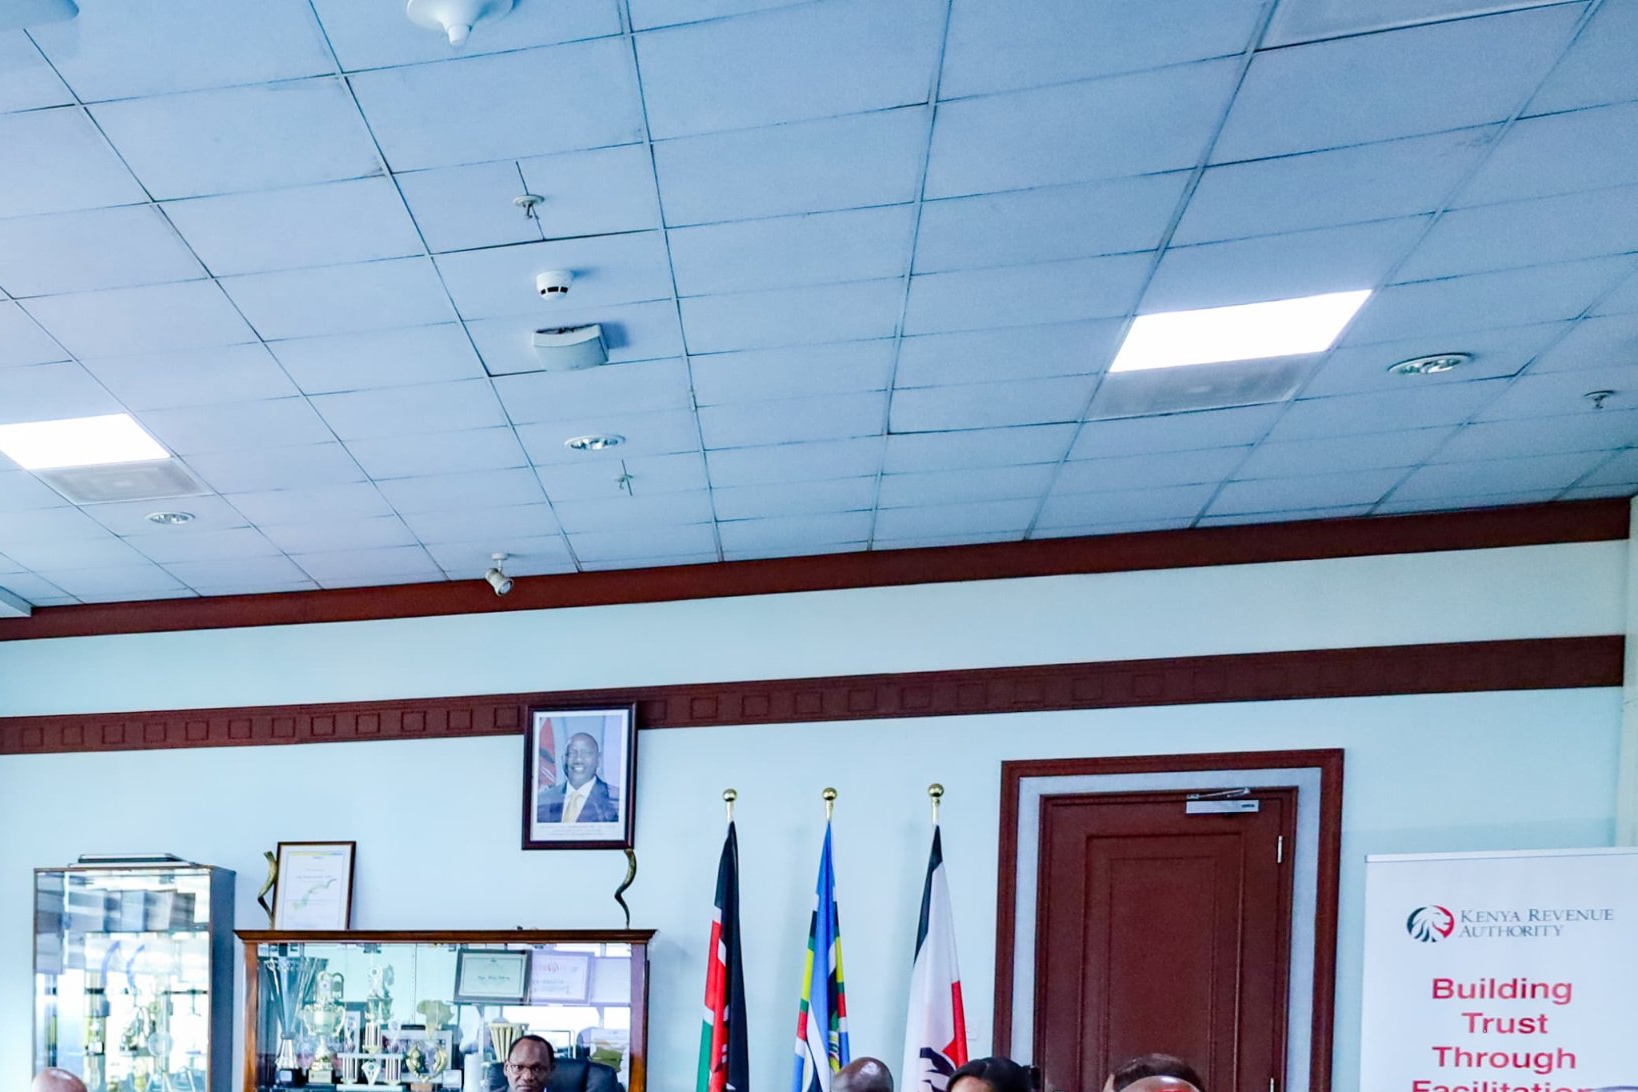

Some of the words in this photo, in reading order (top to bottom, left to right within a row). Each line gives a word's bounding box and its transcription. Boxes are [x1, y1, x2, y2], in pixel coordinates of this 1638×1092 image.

[1461, 910, 1521, 923] KENYA
[1529, 908, 1614, 922] REVENUE
[1459, 925, 1563, 938] AUTHORITY
[1432, 978, 1573, 1005] Building
[1461, 1011, 1549, 1035] Trust
[1432, 1047, 1577, 1075] Through
